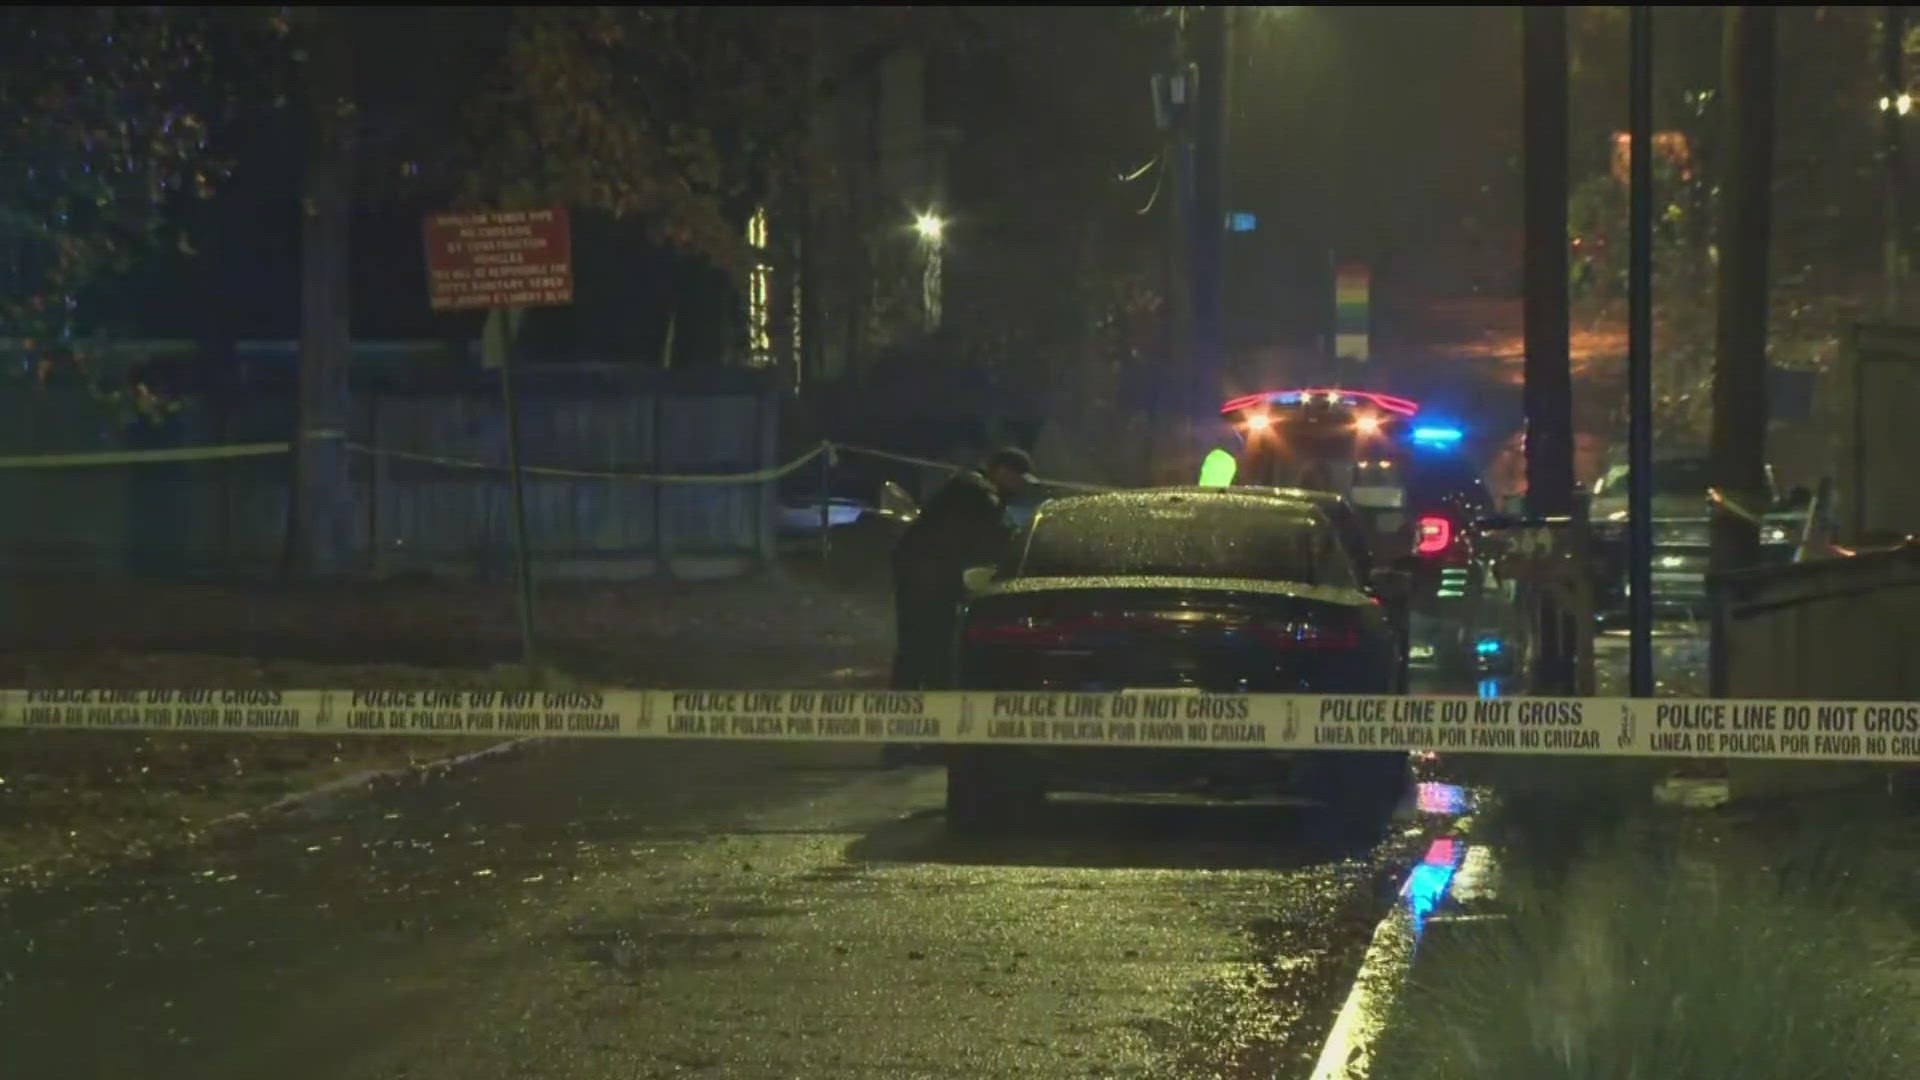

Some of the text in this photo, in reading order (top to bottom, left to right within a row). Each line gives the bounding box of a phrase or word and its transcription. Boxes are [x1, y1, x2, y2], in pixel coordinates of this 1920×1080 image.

[673, 692, 736, 712] POLICE
[743, 692, 783, 713] LINE
[790, 693, 816, 713] DO
[820, 693, 856, 714] NOT
[863, 694, 924, 715] CROSS
[994, 695, 1056, 717] POLICE
[1064, 695, 1104, 718] LINE
[1112, 695, 1137, 718] DO
[1143, 695, 1180, 720] NOT
[1186, 696, 1249, 721] CROSS
[1319, 698, 1386, 722] POLICE
[1392, 699, 1435, 723] LINE
[1441, 700, 1467, 724] DO
[1473, 700, 1512, 725] NOT
[1518, 701, 1583, 726] CROSS
[987, 719, 1266, 743] LINEA DE POLICIA POR FAVOR NO CRUZAR
[1656, 703, 1726, 730] POLICE
[1732, 705, 1776, 730] LINE
[1783, 706, 1810, 731] DO
[1817, 706, 1858, 732] NOT
[1864, 706, 1920, 733] CROS
[1314, 724, 1600, 750] LINEA DE POLICIA POR FAVOR NO CRUZAR
[1650, 732, 1920, 756] LINEA DE POLICIA POR FAVOR NO CRU
